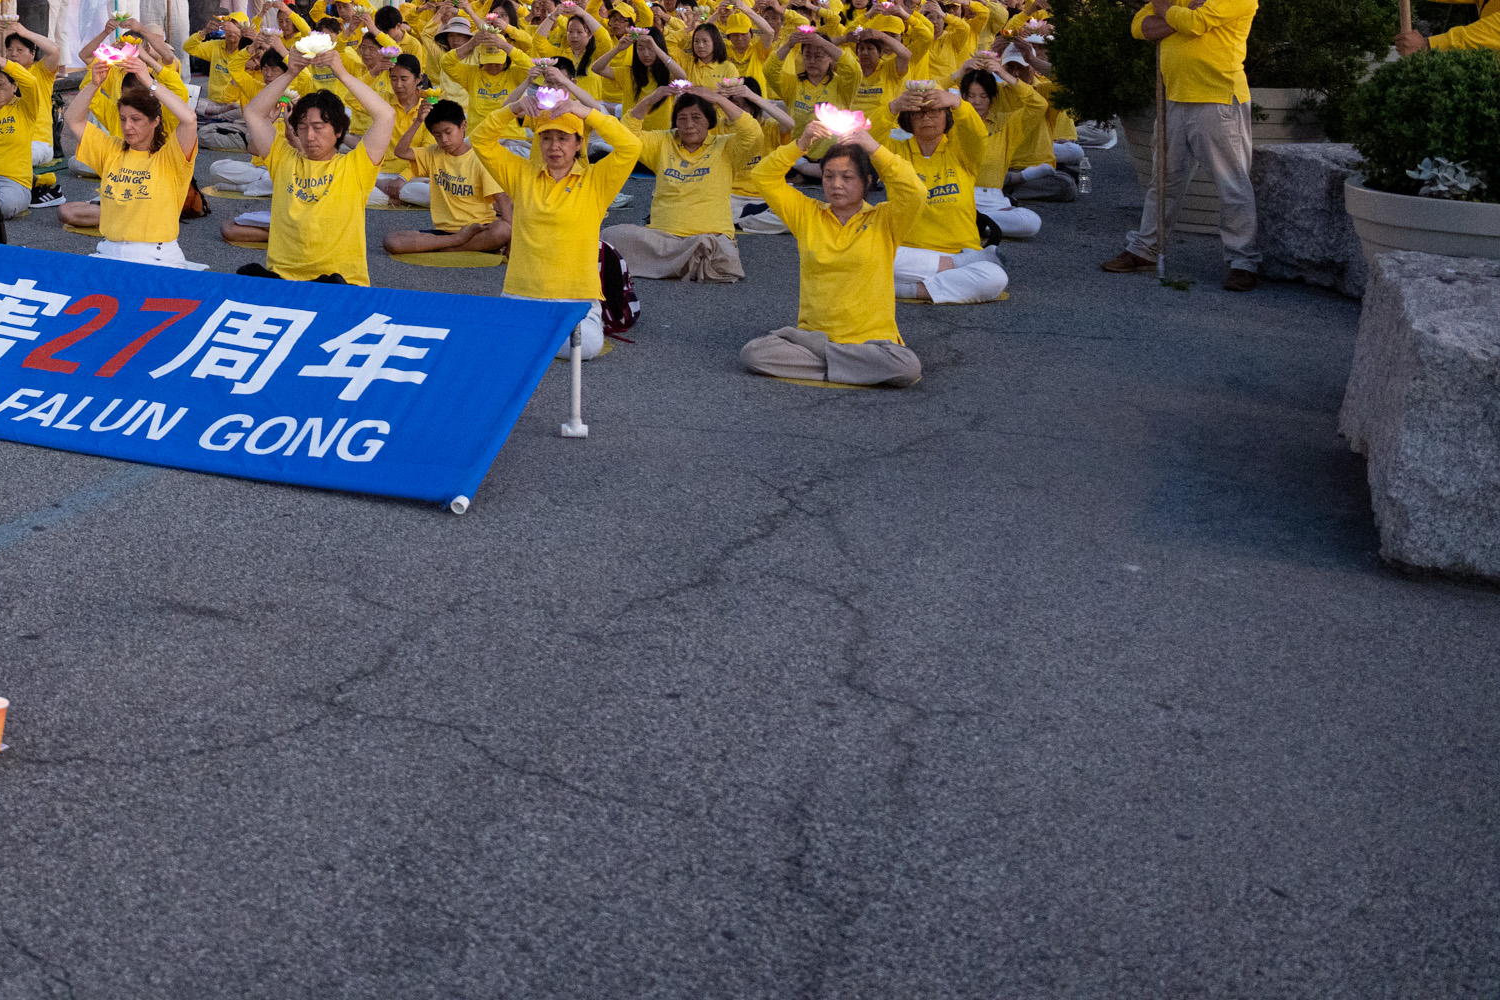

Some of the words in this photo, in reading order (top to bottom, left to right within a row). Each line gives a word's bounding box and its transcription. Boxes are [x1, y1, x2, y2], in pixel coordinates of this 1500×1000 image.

[456, 174, 467, 183] for
[451, 183, 474, 197] DAFA
[198, 412, 392, 463] GONG
